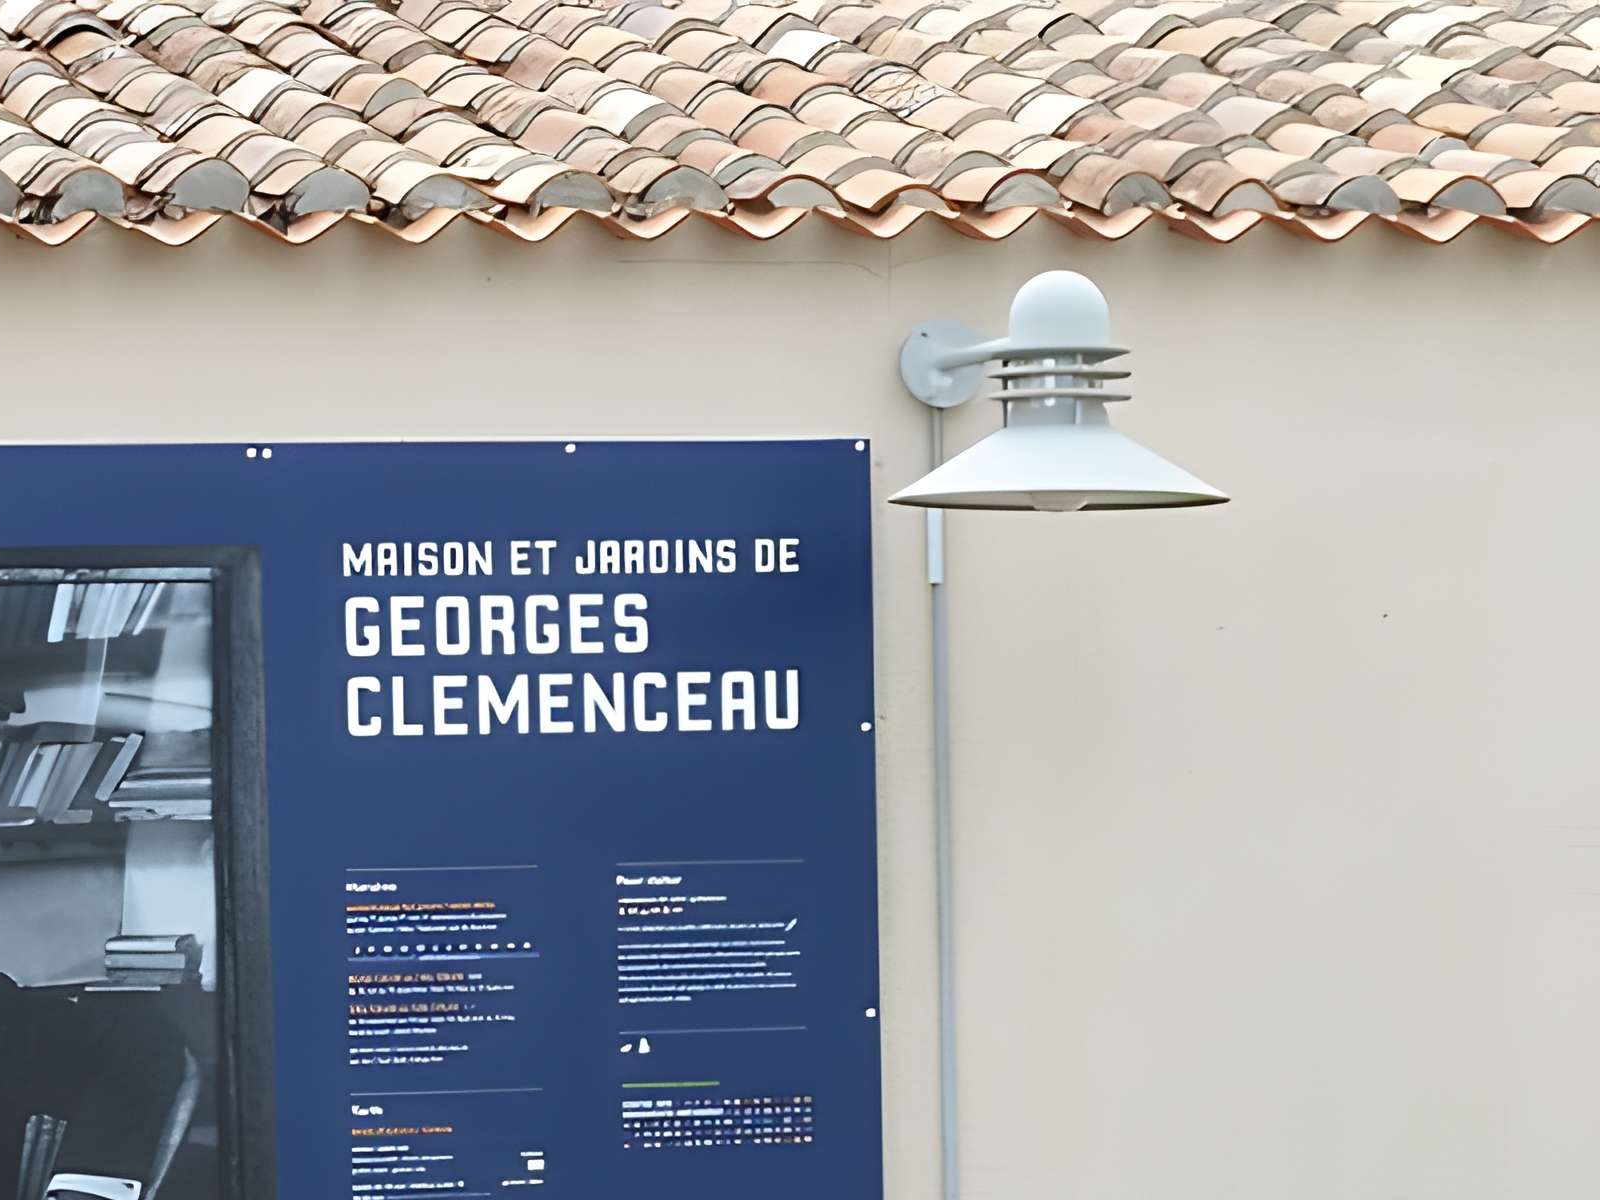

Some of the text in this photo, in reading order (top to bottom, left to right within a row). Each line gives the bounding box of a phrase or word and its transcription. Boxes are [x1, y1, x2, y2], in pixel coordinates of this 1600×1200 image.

[342, 538, 800, 577] MAISON ET JARDINS DE
[344, 593, 649, 657] GEORGES
[346, 669, 799, 737] CLEMENCEAU
